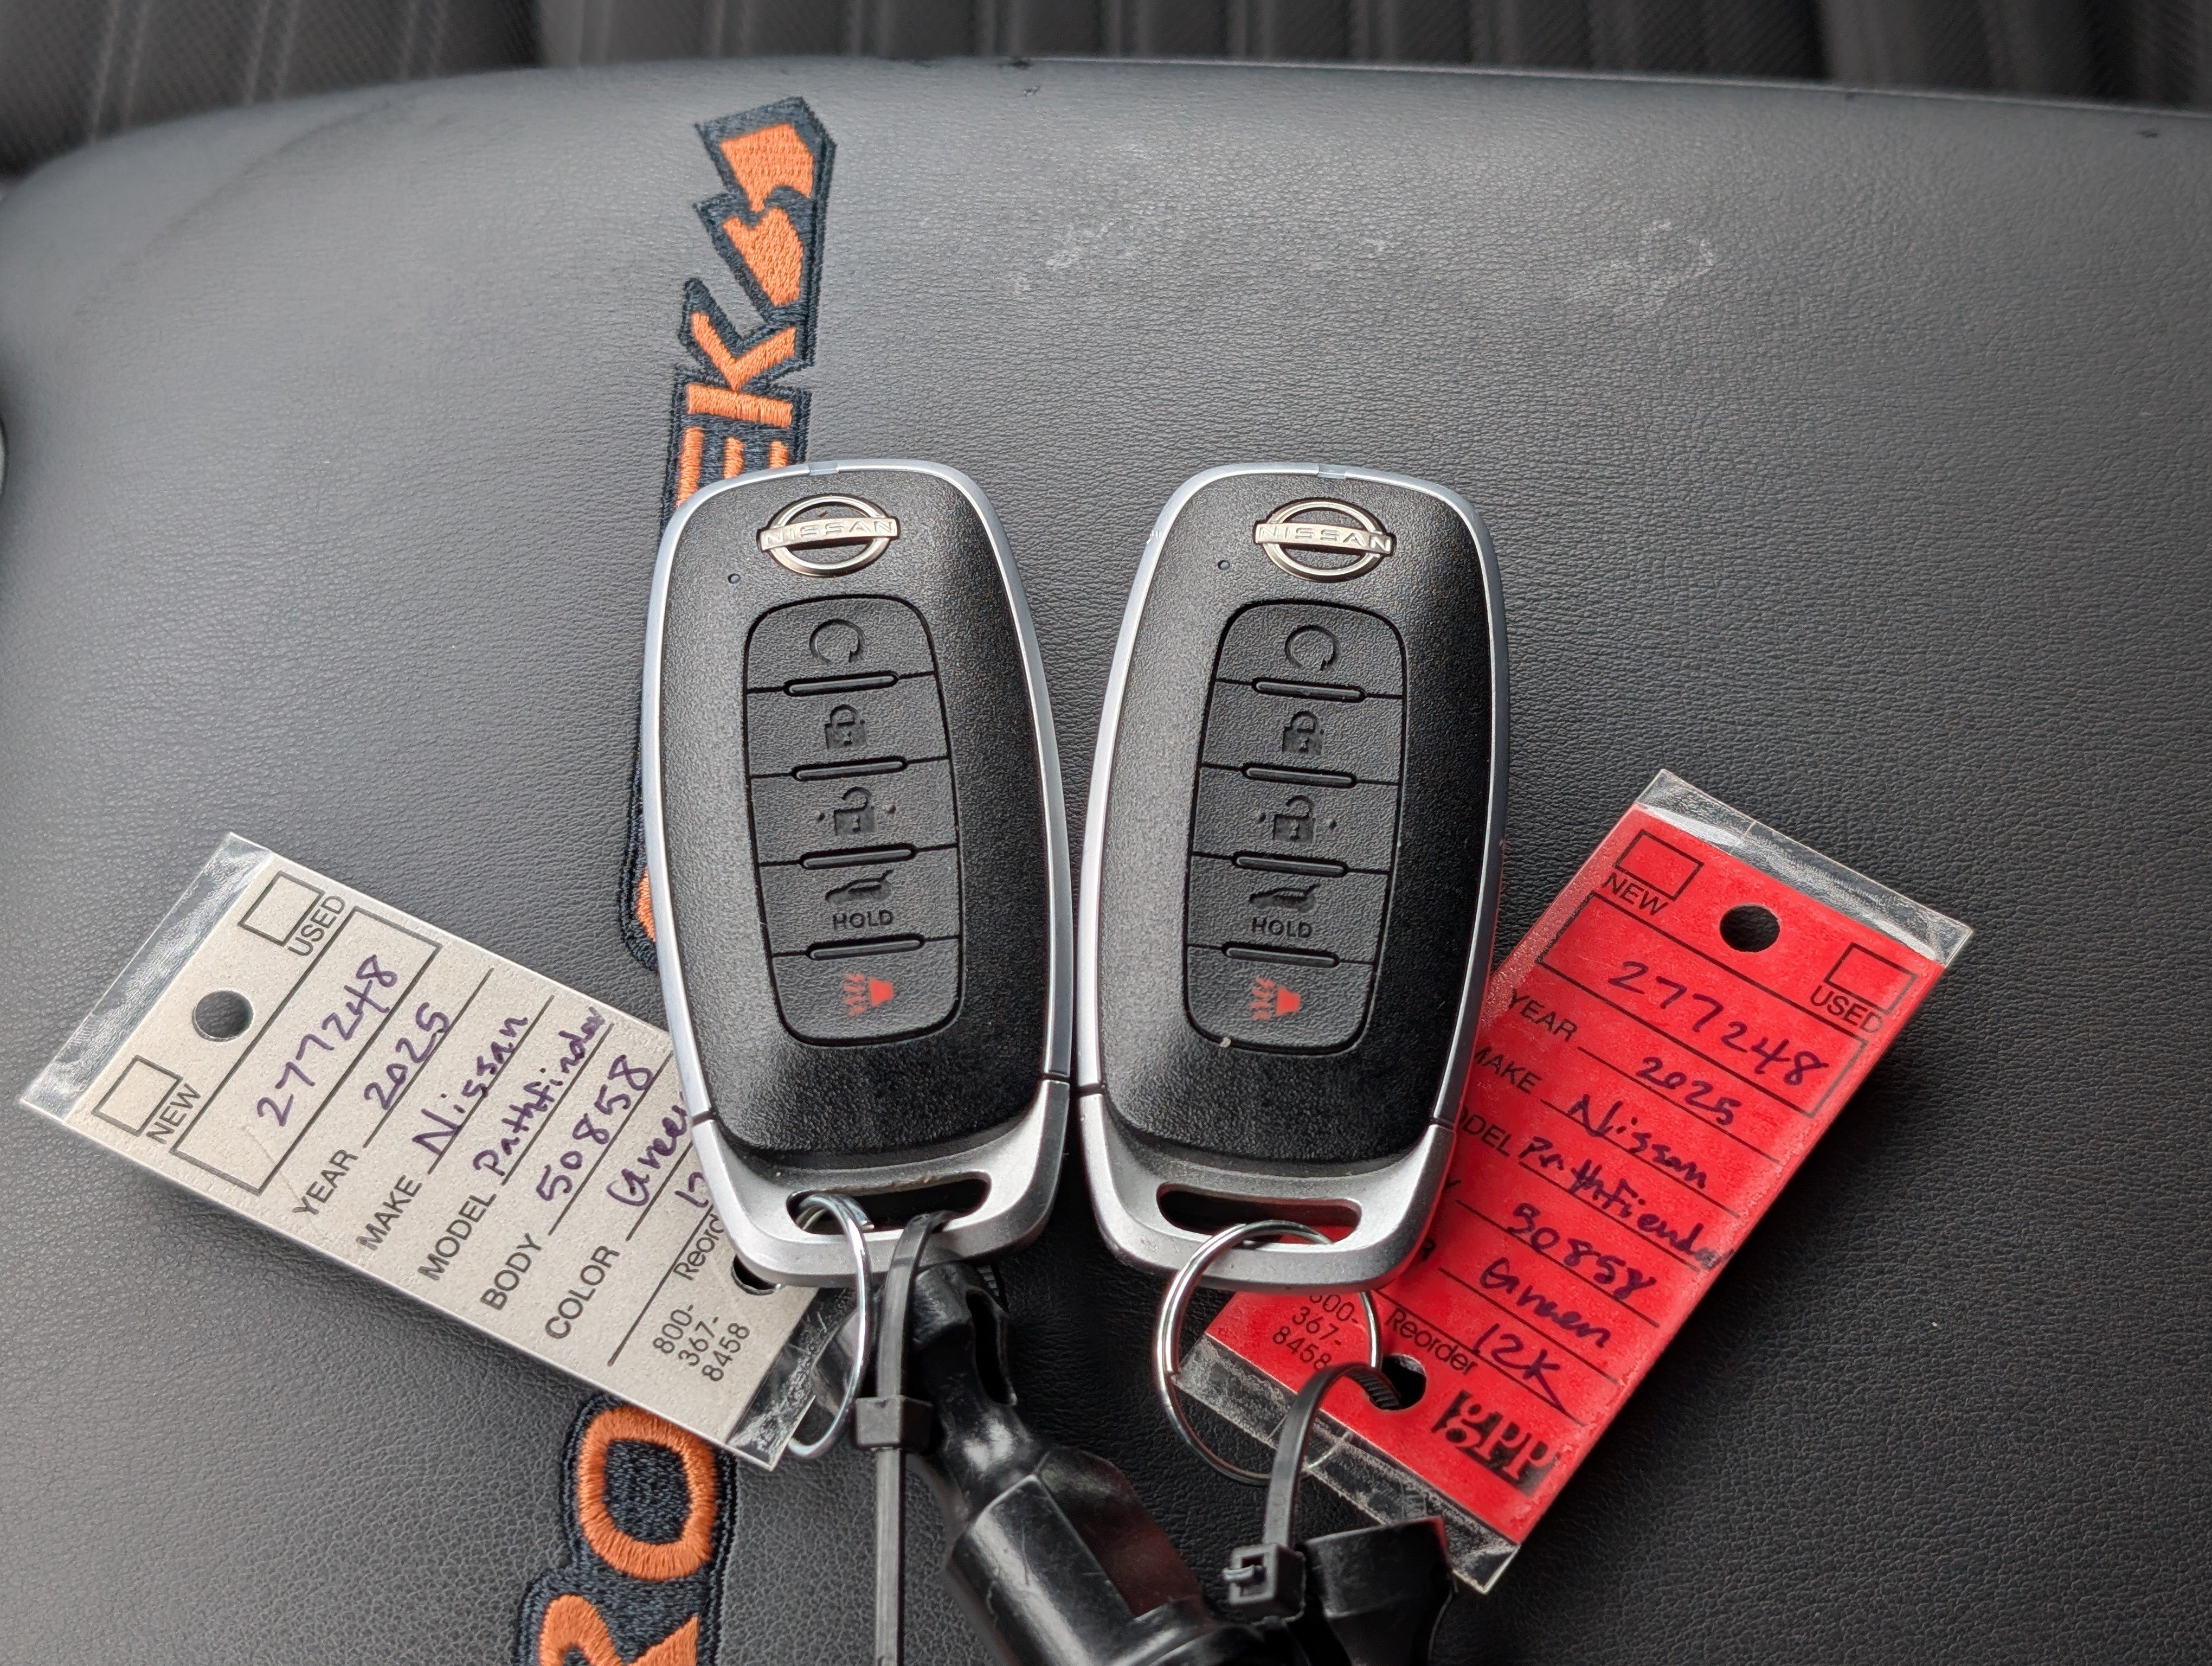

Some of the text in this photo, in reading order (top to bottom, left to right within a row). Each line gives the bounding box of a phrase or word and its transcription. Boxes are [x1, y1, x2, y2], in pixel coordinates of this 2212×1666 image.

[764, 520, 896, 545] NISSAN
[1258, 526, 1392, 552] NISSAN
[287, 895, 346, 957] USED
[833, 909, 893, 930] HOLD
[1601, 873, 1668, 916] NEW
[1252, 917, 1312, 938] HOLD
[258, 954, 398, 1126] 277248
[1510, 991, 1578, 1042] YEAR
[1608, 960, 1829, 1086] 277248
[1810, 985, 1884, 1034] USED
[364, 1002, 449, 1110] 2025
[412, 1017, 528, 1157] Nissan
[146, 1083, 201, 1144] NEW
[1636, 1056, 1742, 1126] 2025
[536, 1054, 652, 1202] 50858
[1567, 1094, 1707, 1189] Nissan
[292, 1149, 358, 1216] YEAR
[356, 1175, 422, 1250] MAKE
[419, 1194, 496, 1280] MODEL
[673, 1213, 725, 1280] Reord
[480, 1233, 542, 1310] BODY
[545, 1246, 620, 1339] COLOR
[653, 1304, 695, 1355] 800-
[678, 1316, 719, 1367] 367-
[702, 1323, 750, 1382] 8458
[1272, 1325, 1333, 1370] 8458
[1291, 1306, 1342, 1346] 367-
[1385, 1308, 1478, 1375] Reorder
